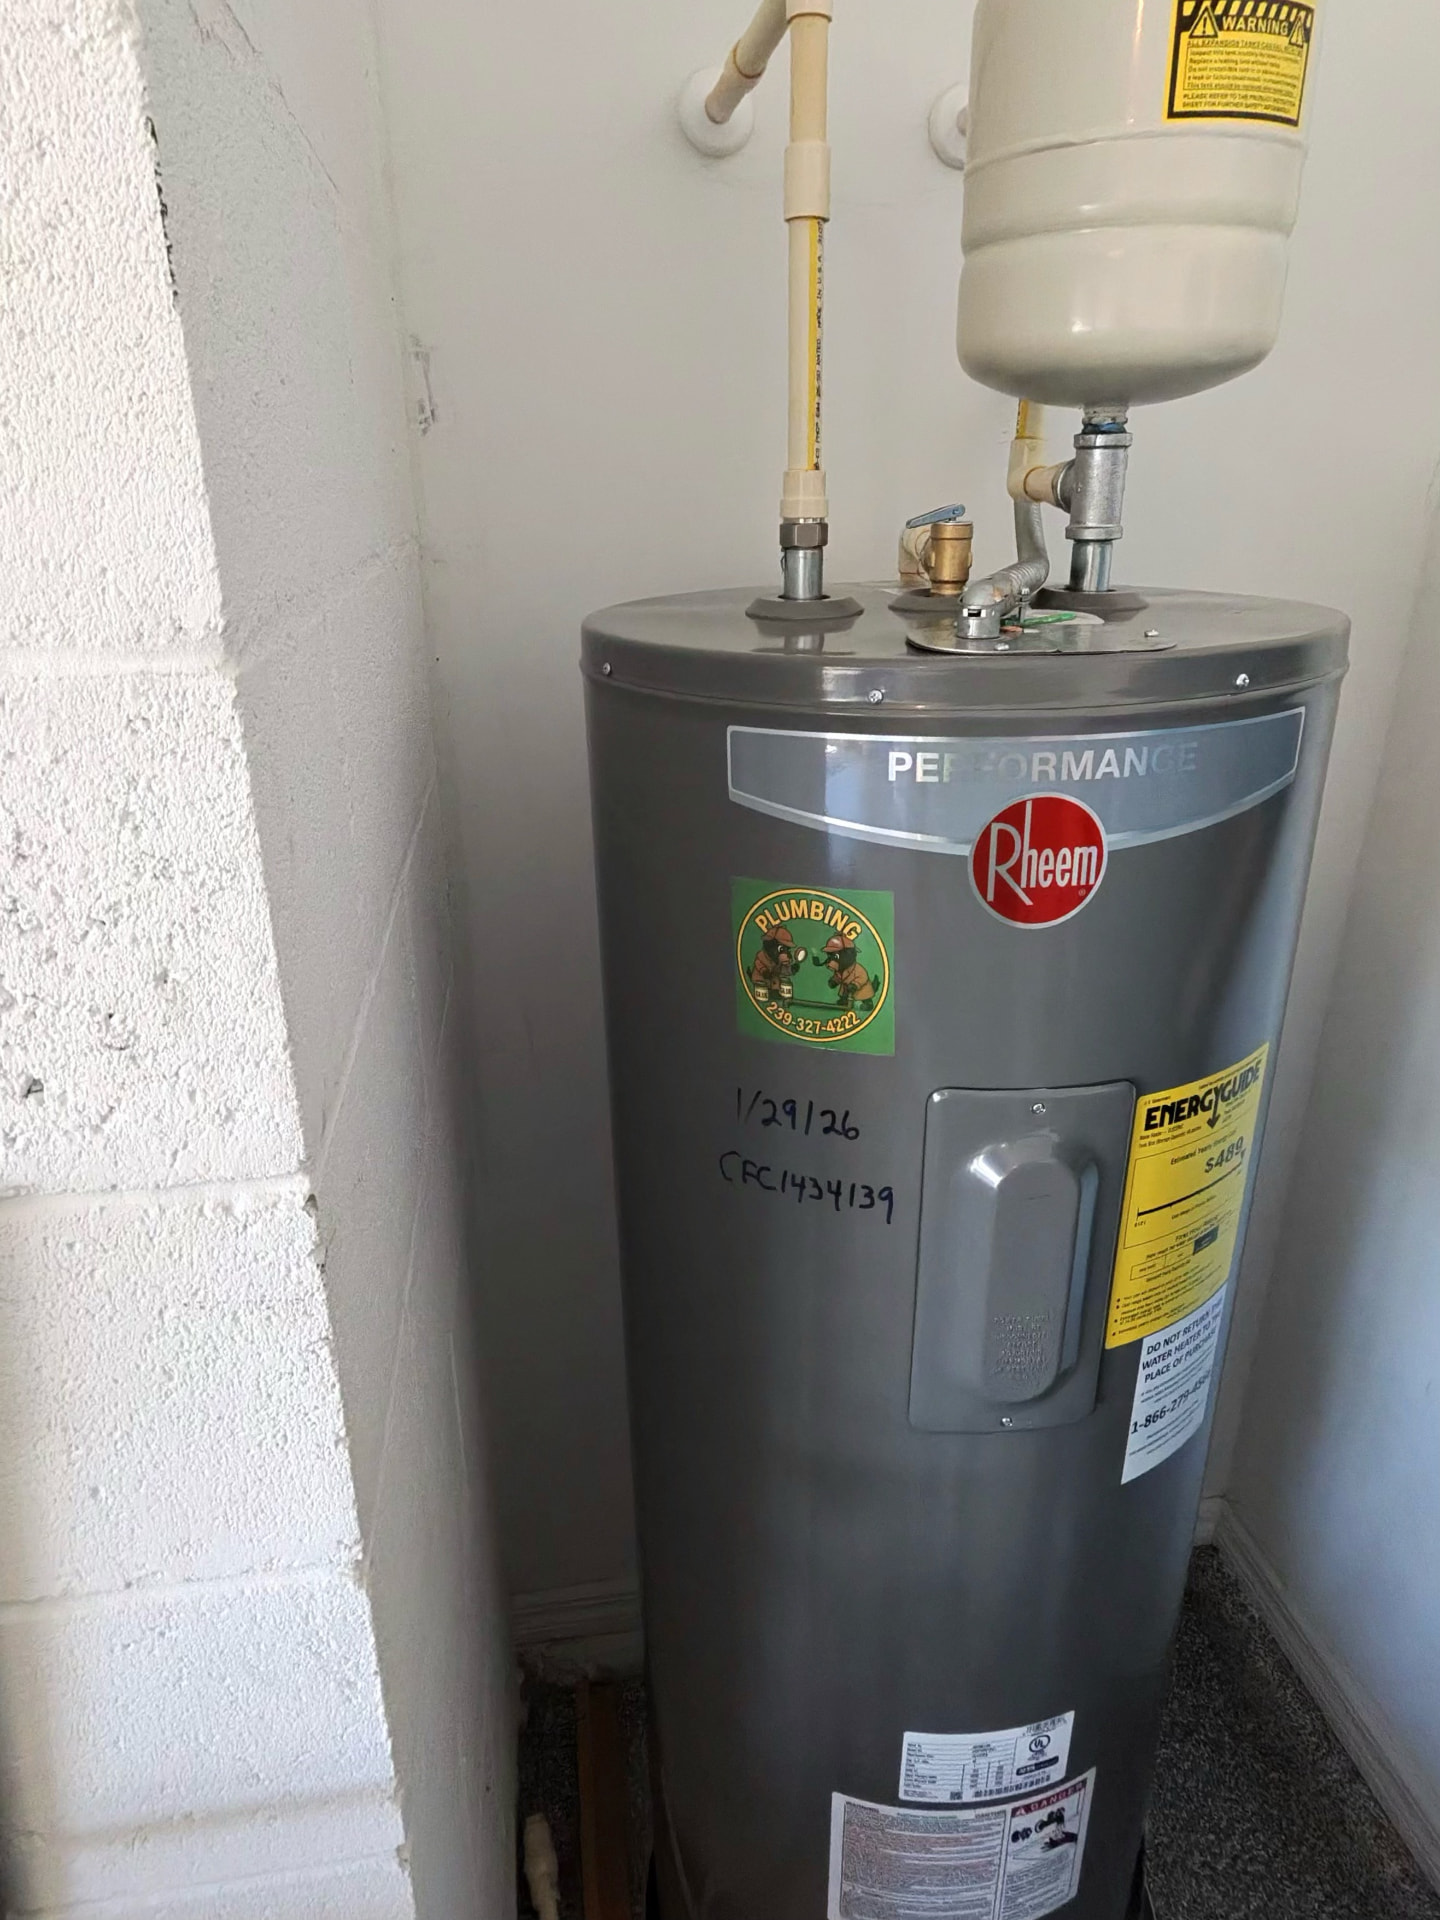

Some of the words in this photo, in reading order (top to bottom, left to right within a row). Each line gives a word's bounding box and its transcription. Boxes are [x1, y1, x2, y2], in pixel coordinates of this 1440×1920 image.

[1222, 15, 1289, 36] WARNING
[987, 800, 1098, 906] Rheem
[755, 899, 862, 940] PLUMBING
[766, 1001, 861, 1034] 239-327-4222
[737, 1087, 860, 1141] 1/29/26
[1142, 1352, 1172, 1371] WATER
[1174, 1329, 1202, 1355] HEATER
[1146, 1341, 1161, 1355] DO
[1163, 1330, 1181, 1348] NOT
[1145, 1365, 1171, 1383] PLACE
[1173, 1355, 1184, 1368] OF
[1030, 1781, 1084, 1811] DANGER
